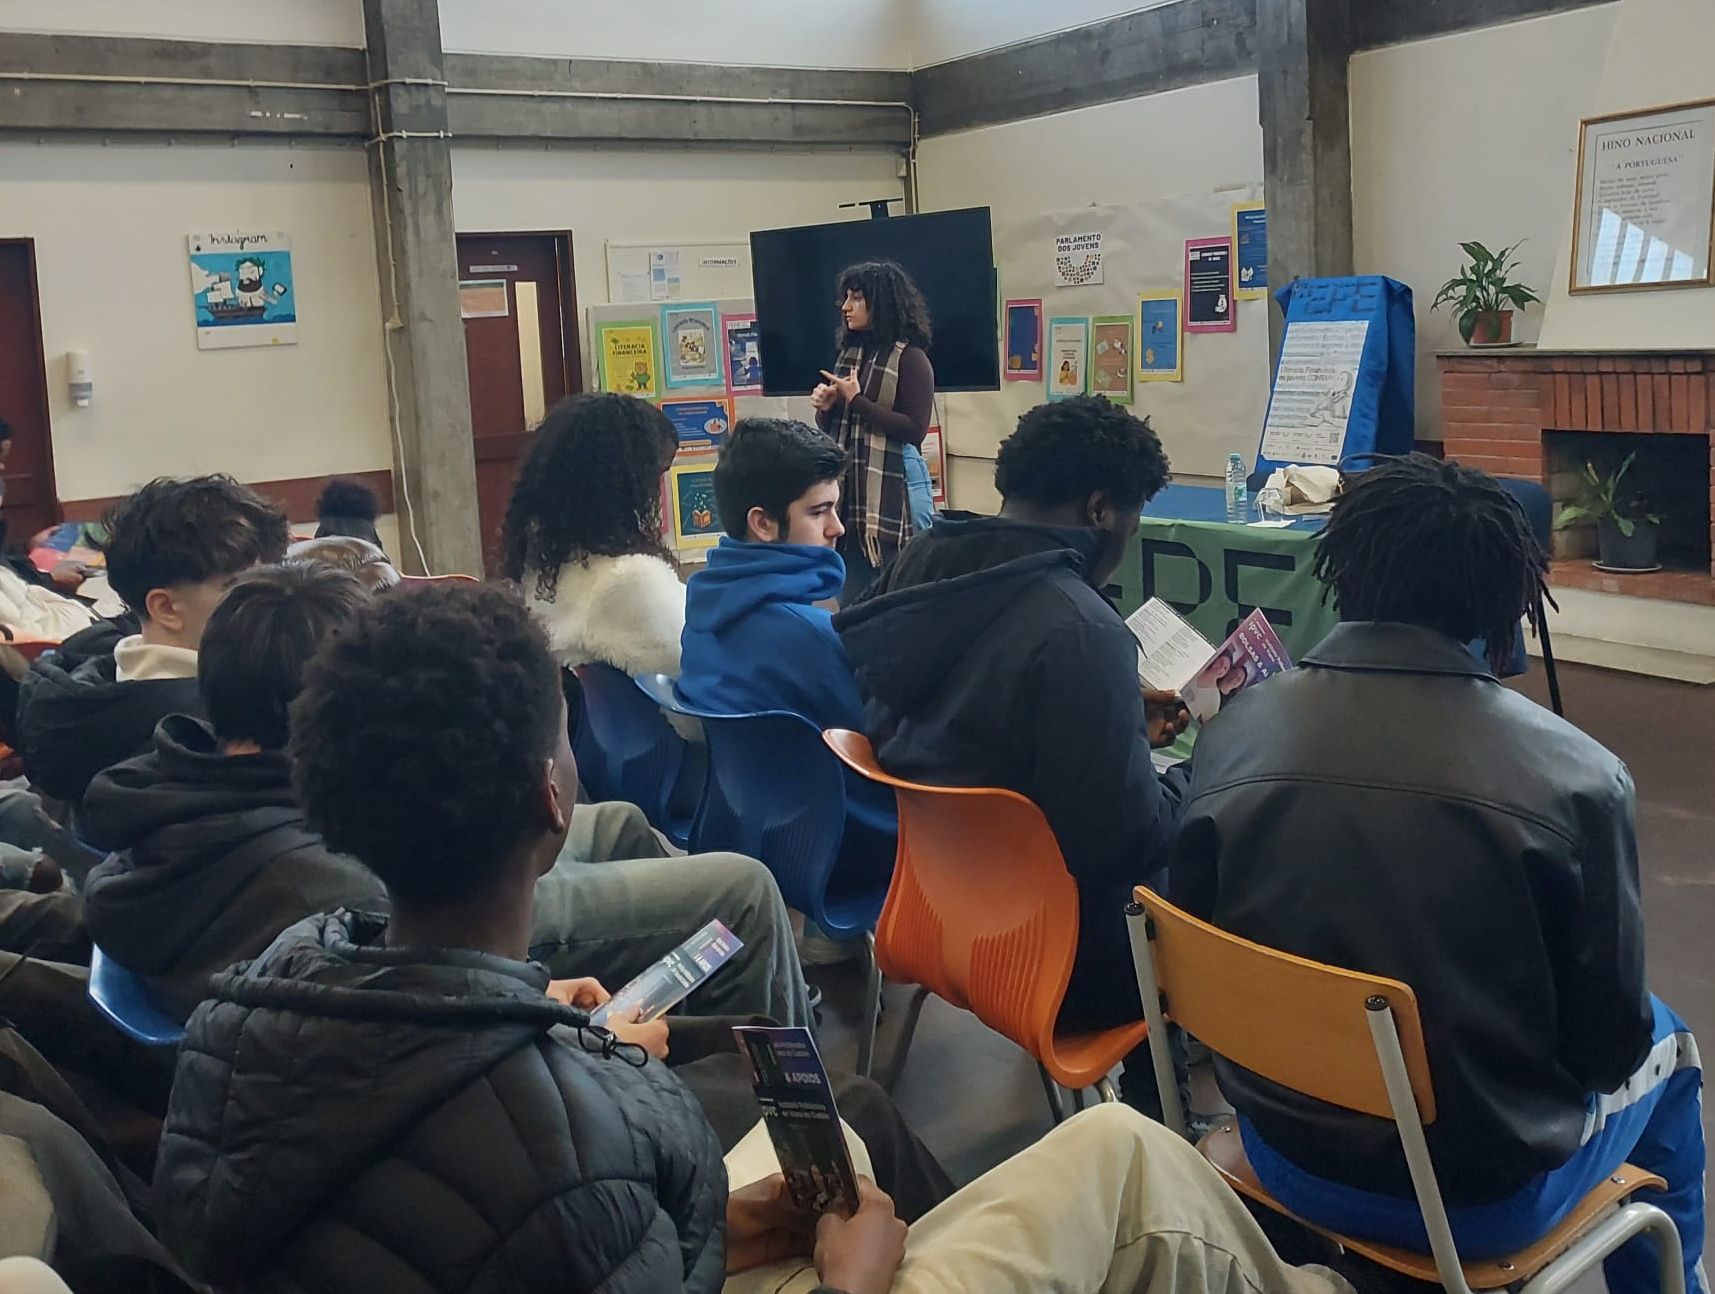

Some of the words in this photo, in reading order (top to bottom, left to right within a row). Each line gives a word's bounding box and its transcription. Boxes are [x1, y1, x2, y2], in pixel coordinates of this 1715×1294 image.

[1602, 138, 1632, 151] HINO
[1634, 129, 1696, 146] NACIONAL
[1056, 234, 1101, 245] PARLAMENTO
[1072, 242, 1099, 251] JOVENS
[612, 349, 647, 357] FINANCEIRA
[1239, 632, 1260, 663] BOLSAS
